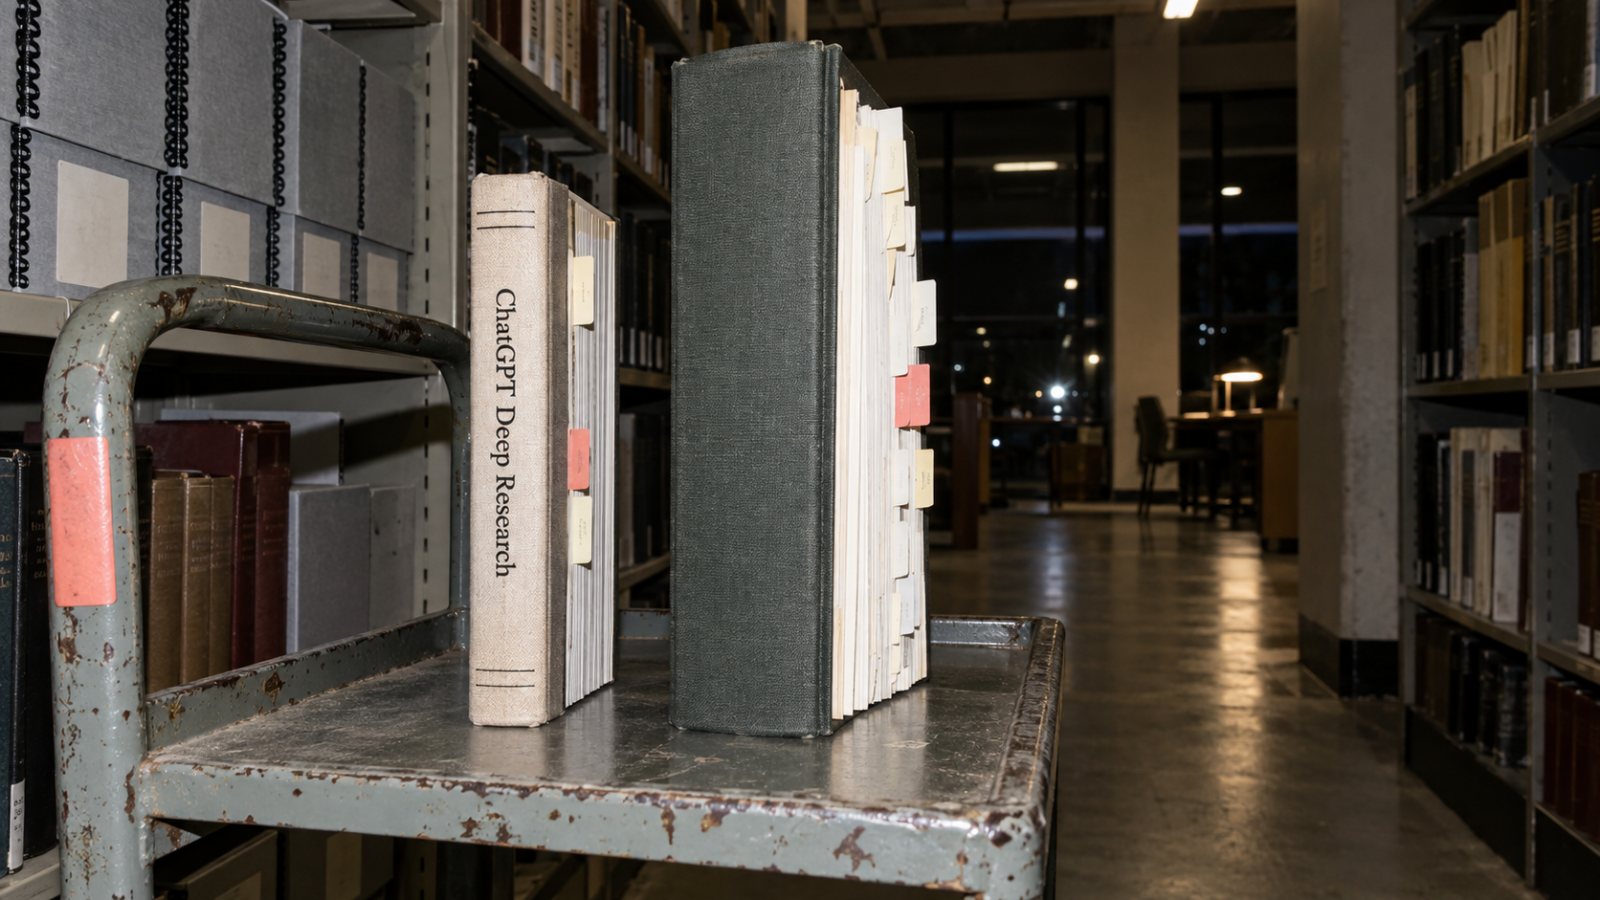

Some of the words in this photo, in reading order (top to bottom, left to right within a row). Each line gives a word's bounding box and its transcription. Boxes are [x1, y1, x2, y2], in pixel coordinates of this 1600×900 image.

[495, 288, 516, 397] ChatGPT
[490, 406, 516, 467] Deep
[495, 475, 517, 578] Research
